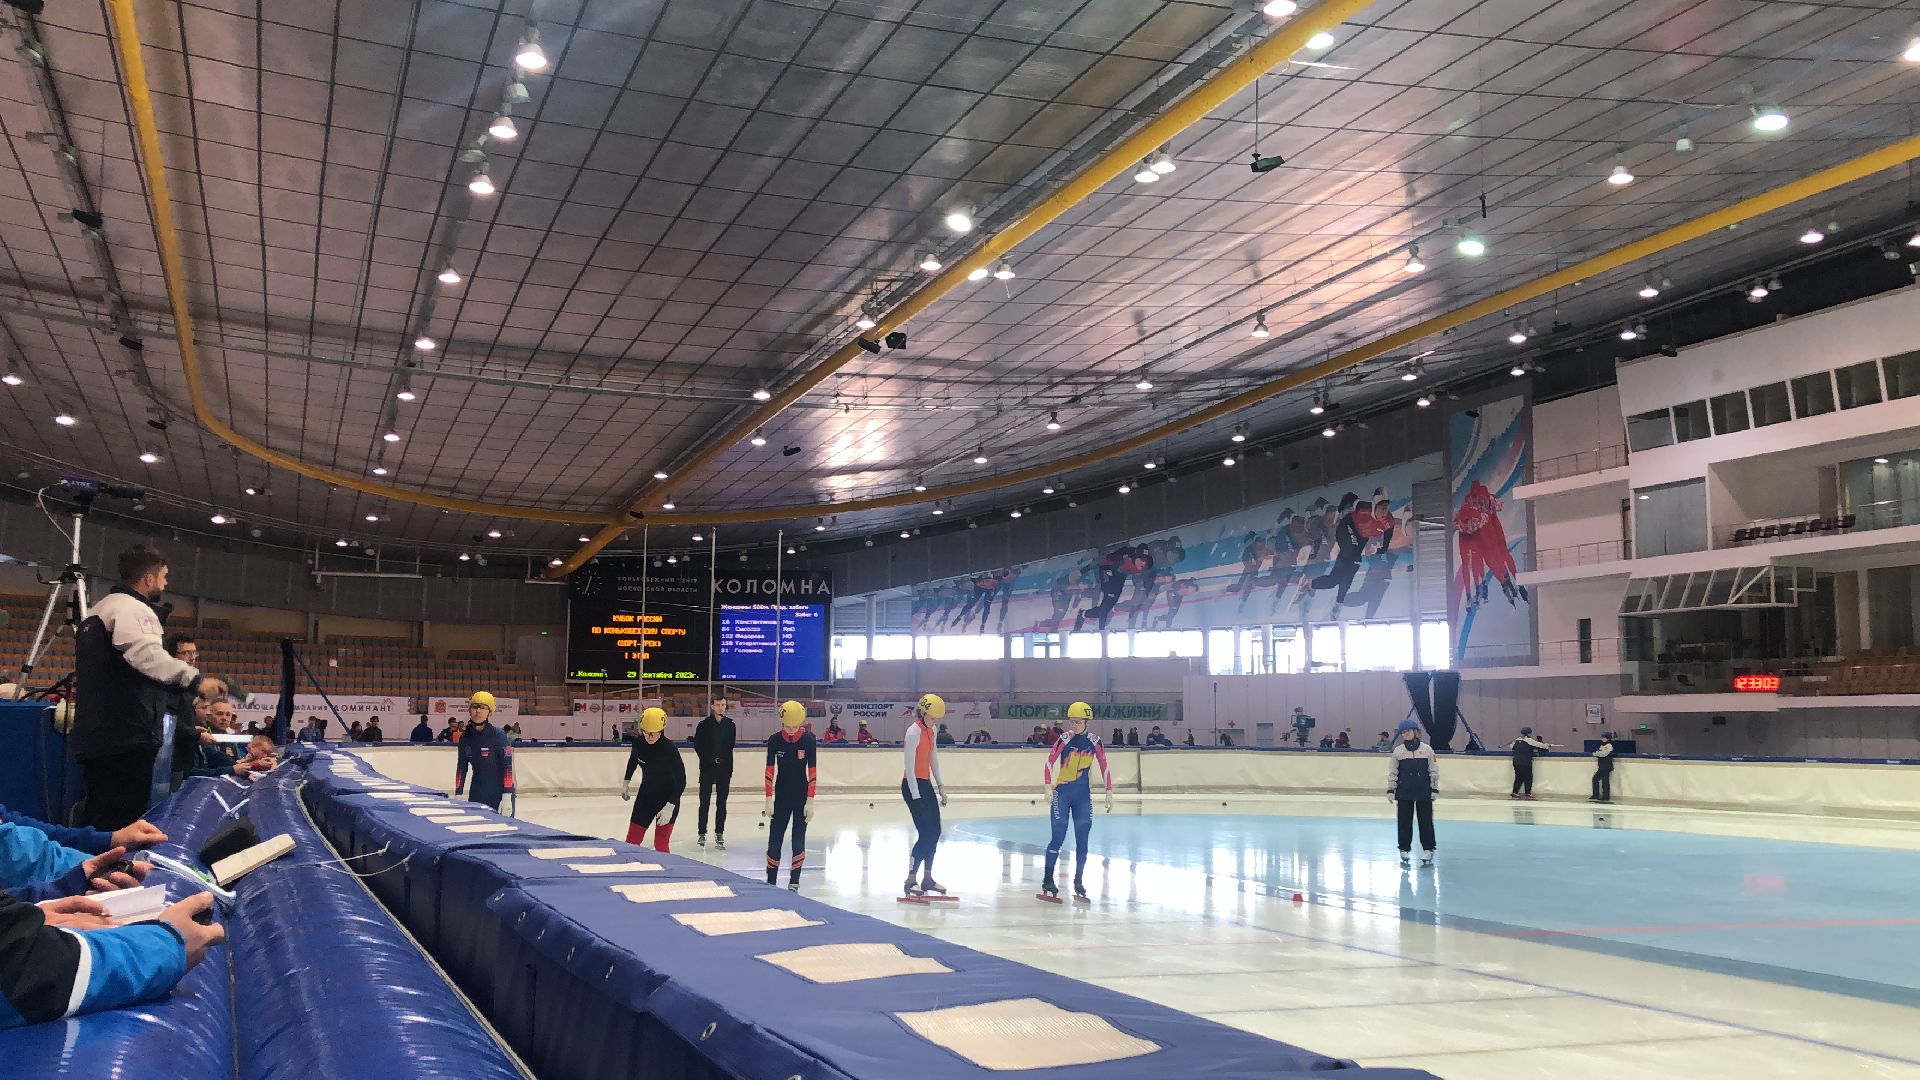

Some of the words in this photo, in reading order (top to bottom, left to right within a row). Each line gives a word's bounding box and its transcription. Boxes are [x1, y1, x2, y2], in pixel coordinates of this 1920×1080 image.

[712, 579, 831, 595] КОЛОМНА
[846, 703, 894, 711] МИНСПОРТ
[1008, 704, 1050, 718] СПОРТ
[854, 710, 888, 719] РОССИИ
